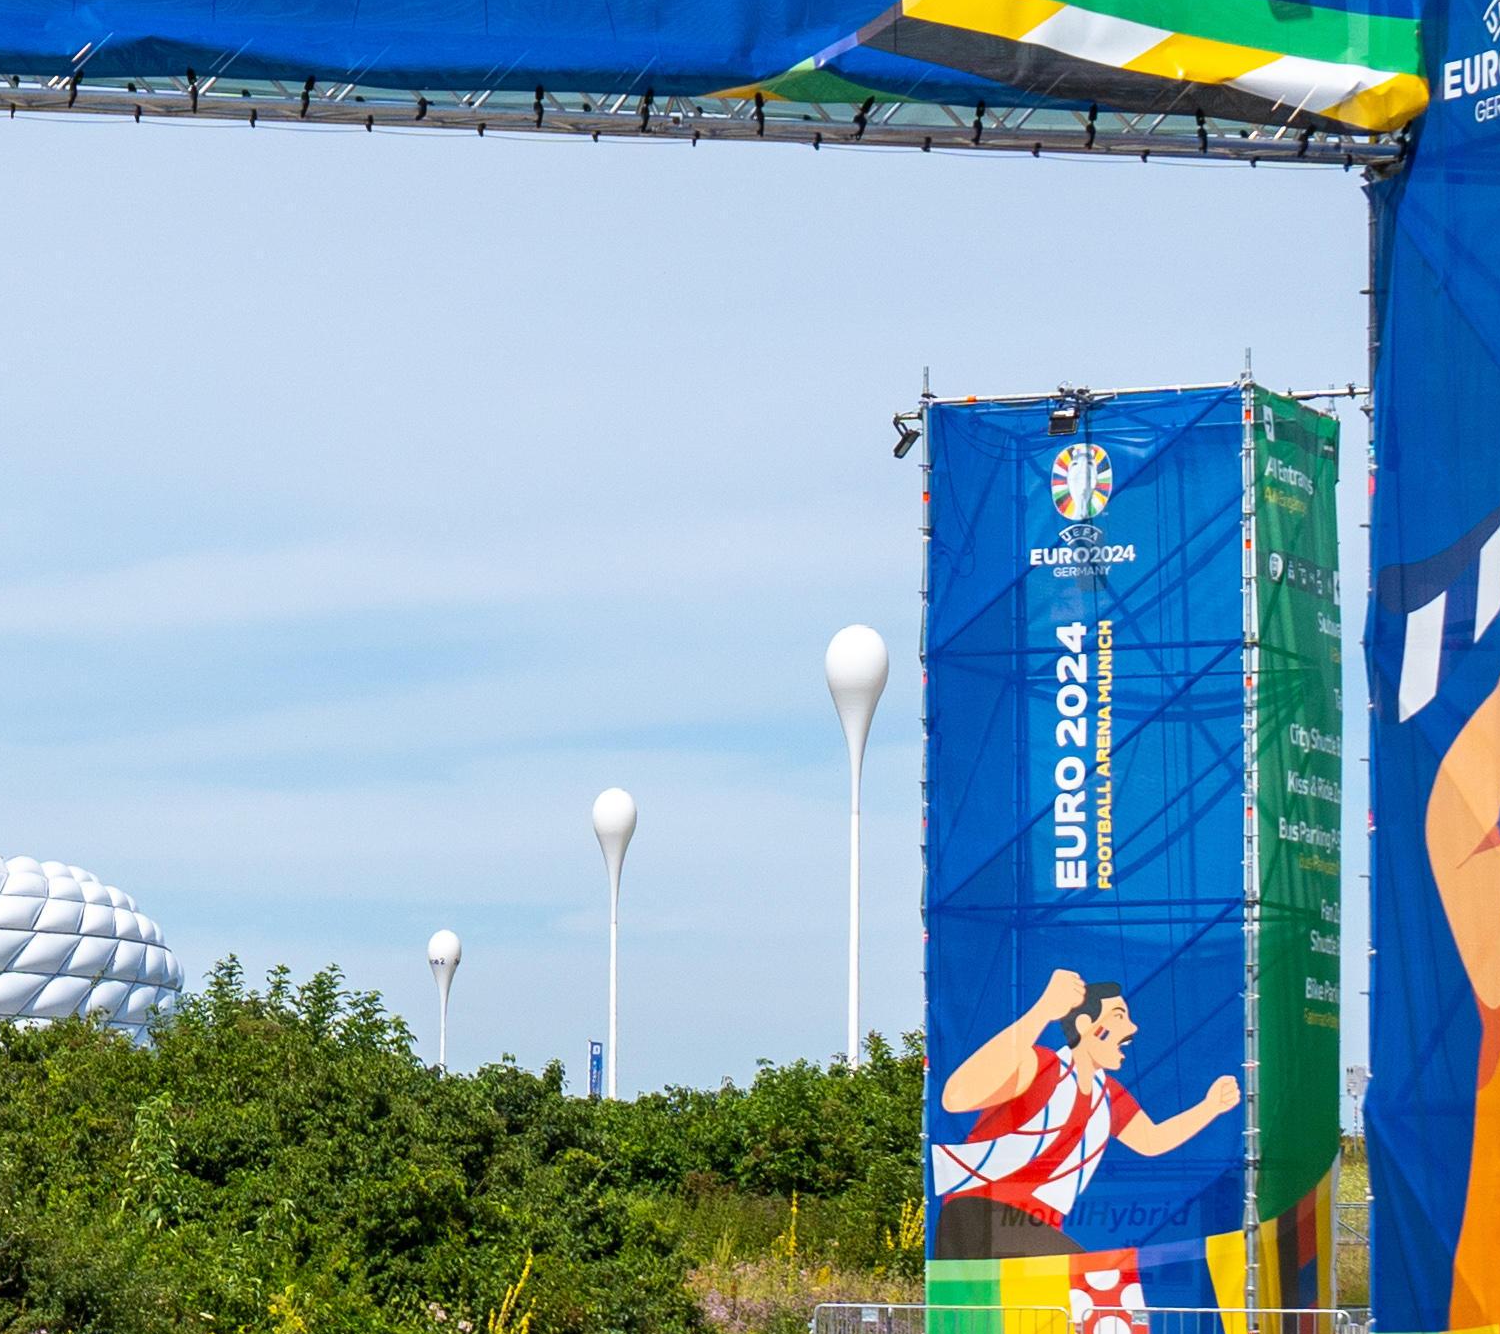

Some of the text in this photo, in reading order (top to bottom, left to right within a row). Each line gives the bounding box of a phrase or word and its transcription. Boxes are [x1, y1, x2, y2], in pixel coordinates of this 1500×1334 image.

[1061, 526, 1098, 543] UEFA
[1029, 544, 1136, 566] EURO2024
[1052, 565, 1112, 578] GERMANY
[1054, 621, 1088, 889] EURO 2024
[1096, 620, 1112, 890] FOOTBALL ARENA MUNICH
[1279, 817, 1299, 842] Bus
